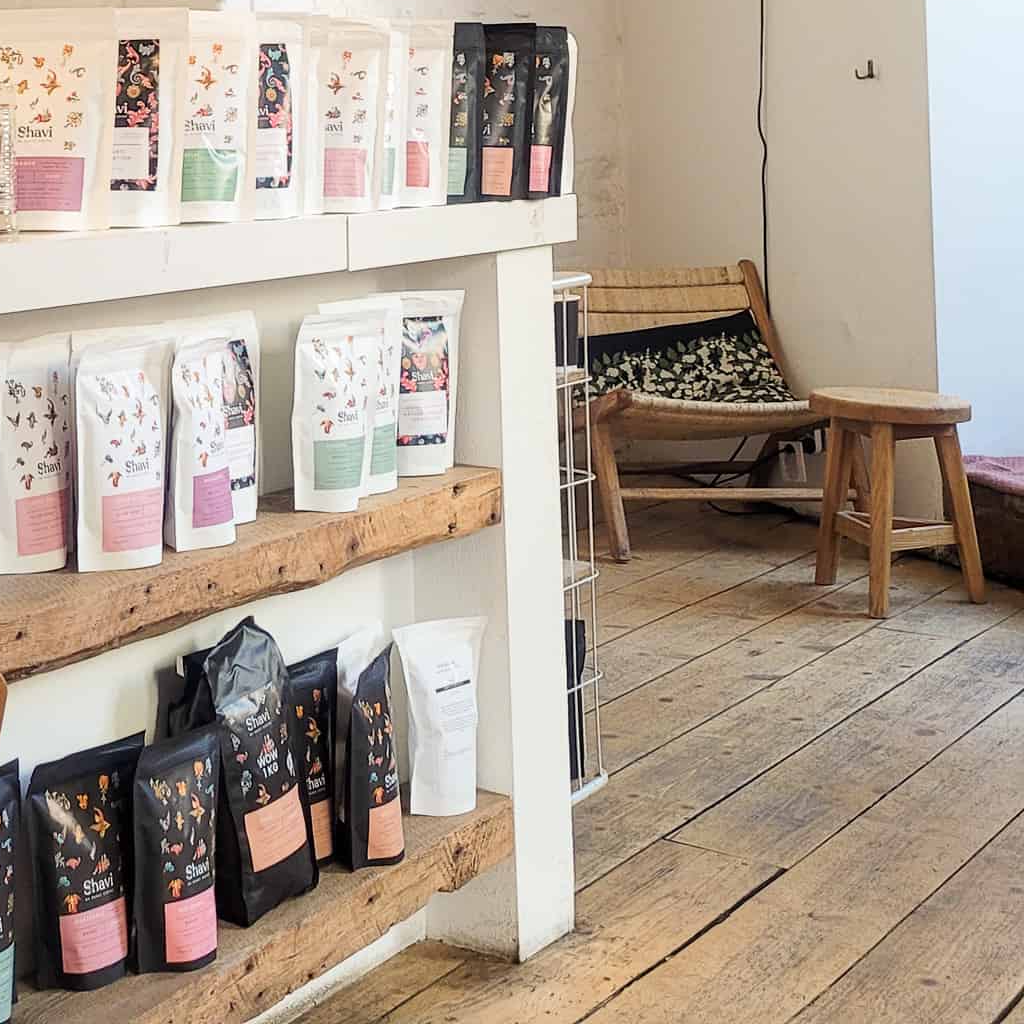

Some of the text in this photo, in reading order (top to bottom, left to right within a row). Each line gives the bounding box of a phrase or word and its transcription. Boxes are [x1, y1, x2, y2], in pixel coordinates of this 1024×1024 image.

[17, 126, 53, 138] Shavi
[184, 119, 216, 132] Shavi
[37, 460, 61, 475] Shavi
[126, 460, 150, 474] Shavi
[245, 707, 271, 731] Shavi
[257, 747, 278, 769] WOW
[306, 772, 326, 790] havi
[185, 856, 210, 881] Shavi
[83, 872, 114, 896] Shavi
